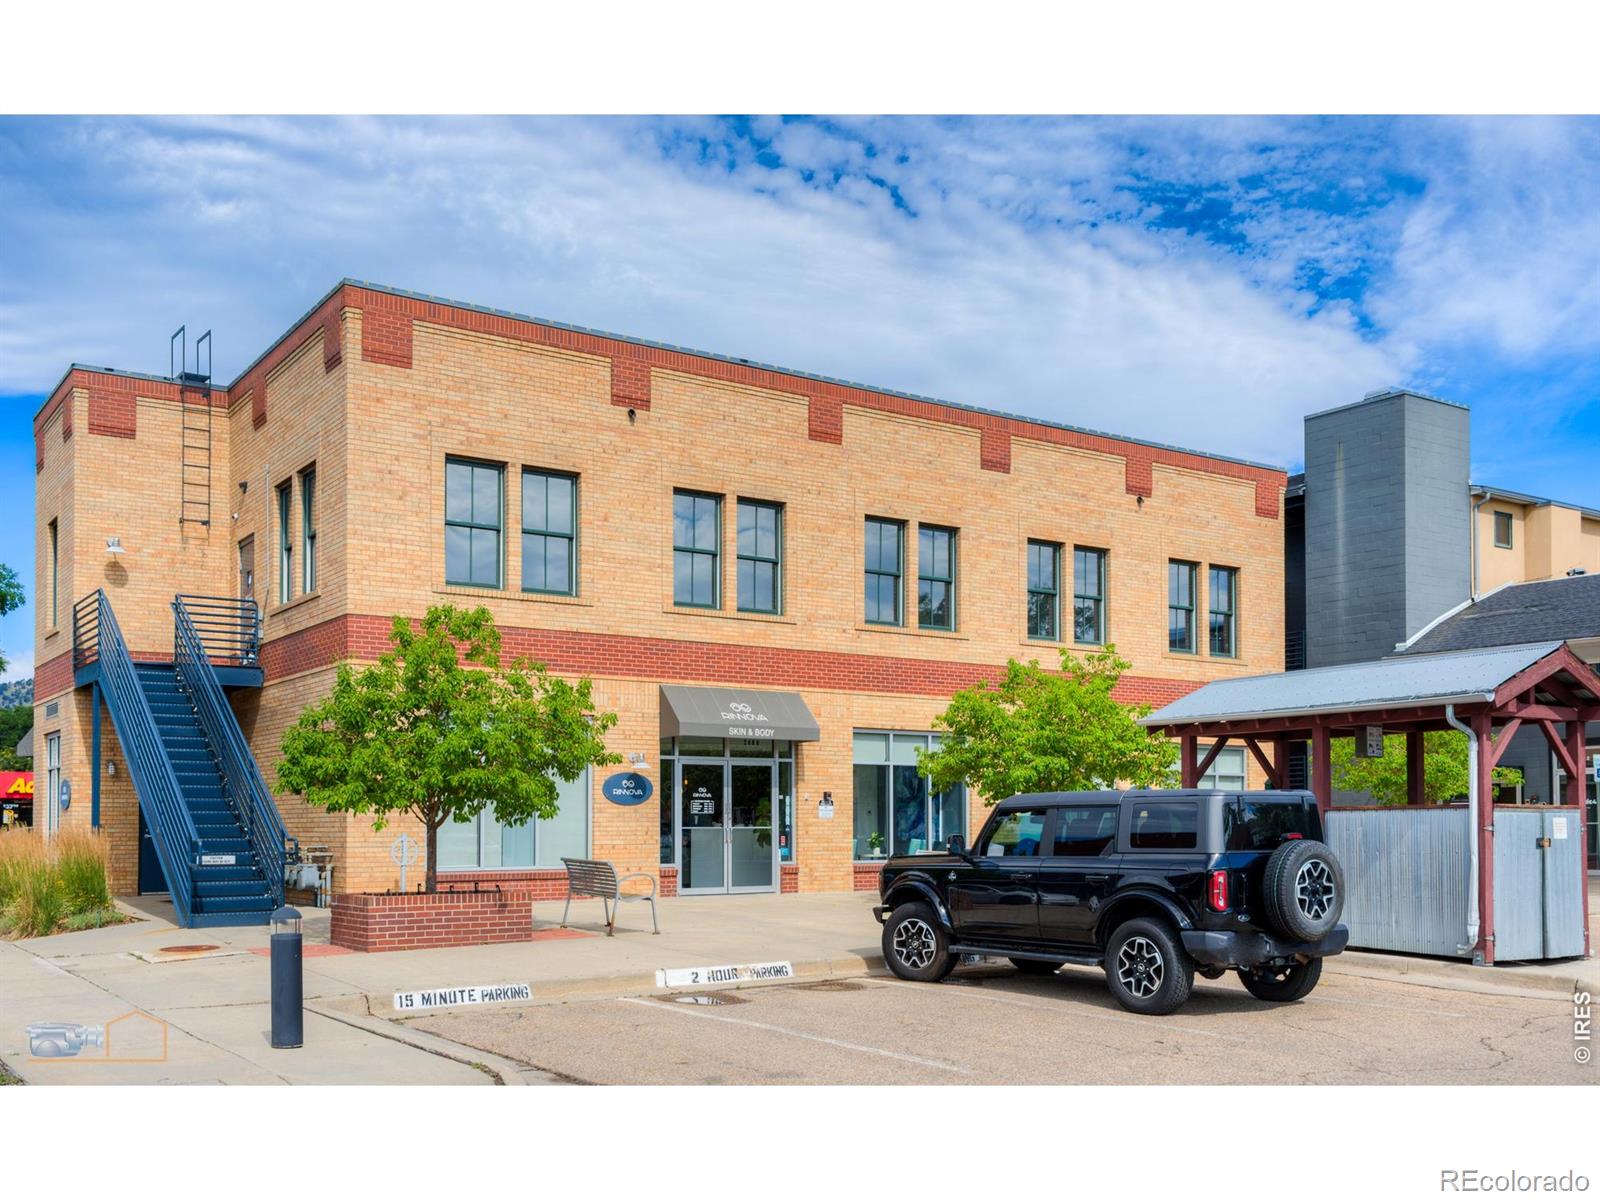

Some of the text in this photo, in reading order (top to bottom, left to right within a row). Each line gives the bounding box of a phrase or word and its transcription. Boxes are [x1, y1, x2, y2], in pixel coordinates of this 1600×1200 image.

[728, 727, 746, 736] SKIN
[755, 728, 775, 737] BODY
[691, 964, 789, 984] 2 HOUR PARKING
[399, 985, 529, 1008] 15 MINUTE PARKING
